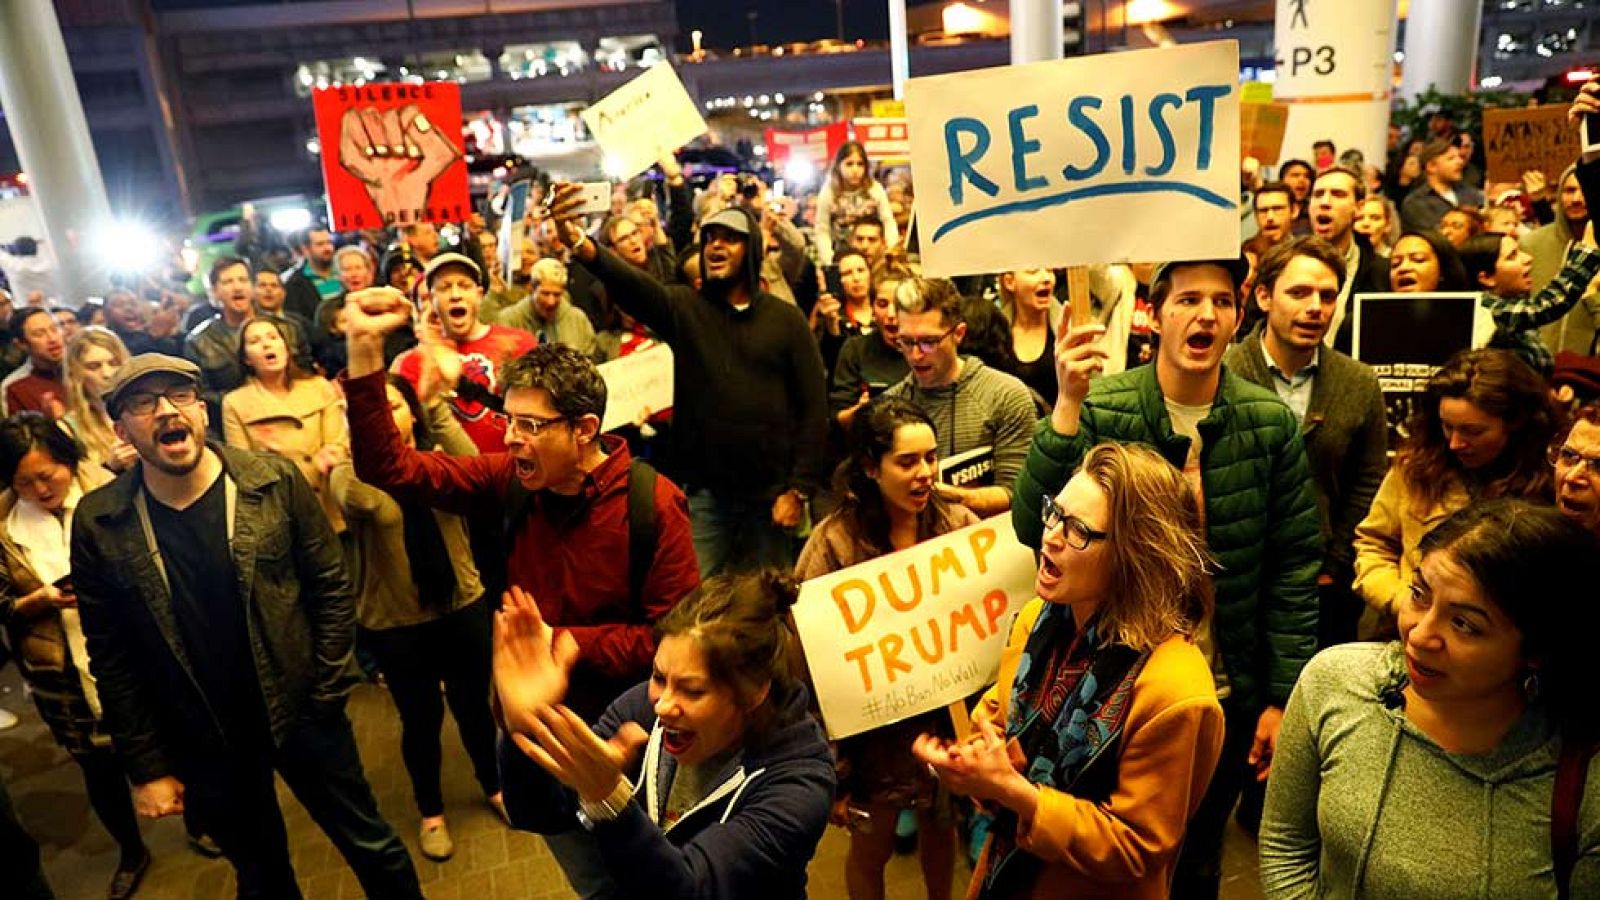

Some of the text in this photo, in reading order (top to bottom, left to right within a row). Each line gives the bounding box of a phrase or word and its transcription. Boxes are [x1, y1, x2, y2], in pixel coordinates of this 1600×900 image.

[338, 86, 434, 101] SILENCE
[1292, 46, 1336, 77] P3
[944, 84, 1232, 205] RESIST
[830, 527, 997, 635] DUMP
[844, 588, 1009, 694] TRUMP
